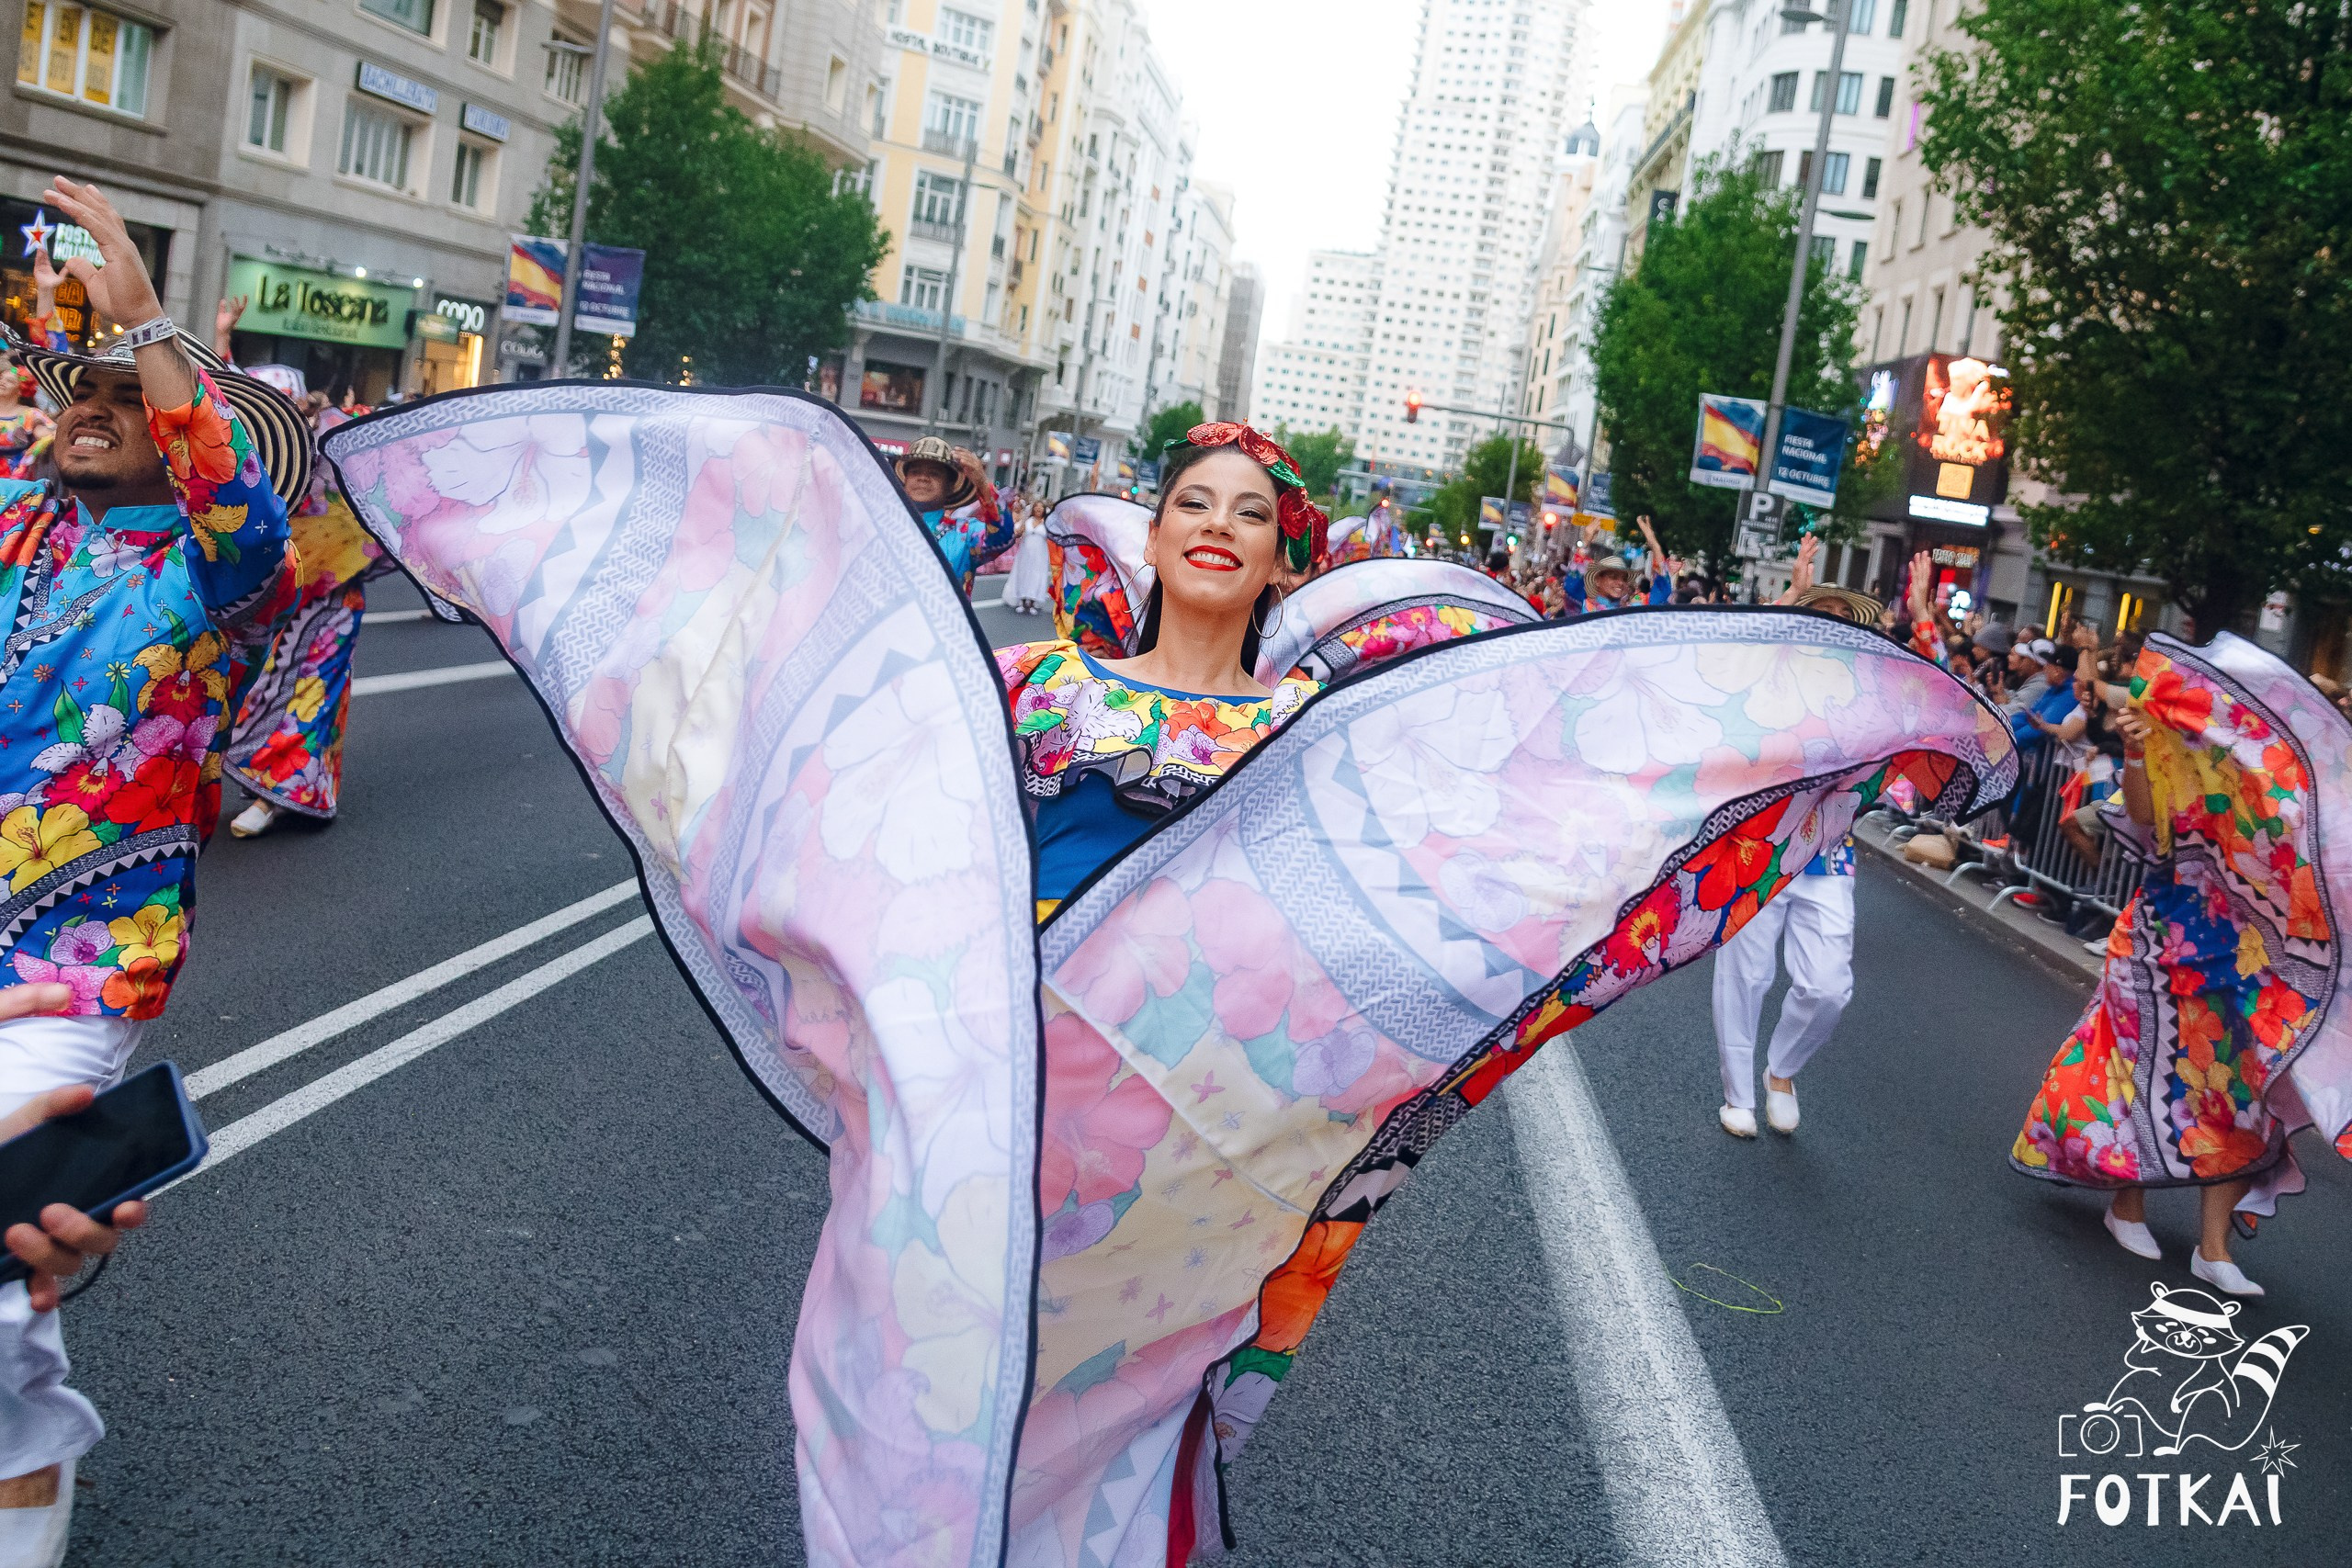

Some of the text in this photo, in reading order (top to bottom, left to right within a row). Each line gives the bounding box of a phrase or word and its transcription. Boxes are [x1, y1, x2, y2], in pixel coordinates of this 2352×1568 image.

[255, 273, 389, 325] La Toscana
[1784, 434, 1814, 449] FIESTA
[1781, 445, 1827, 465] NACIONAL
[1777, 466, 1830, 489] 12 OCTUBRE
[1748, 491, 1775, 521] P
